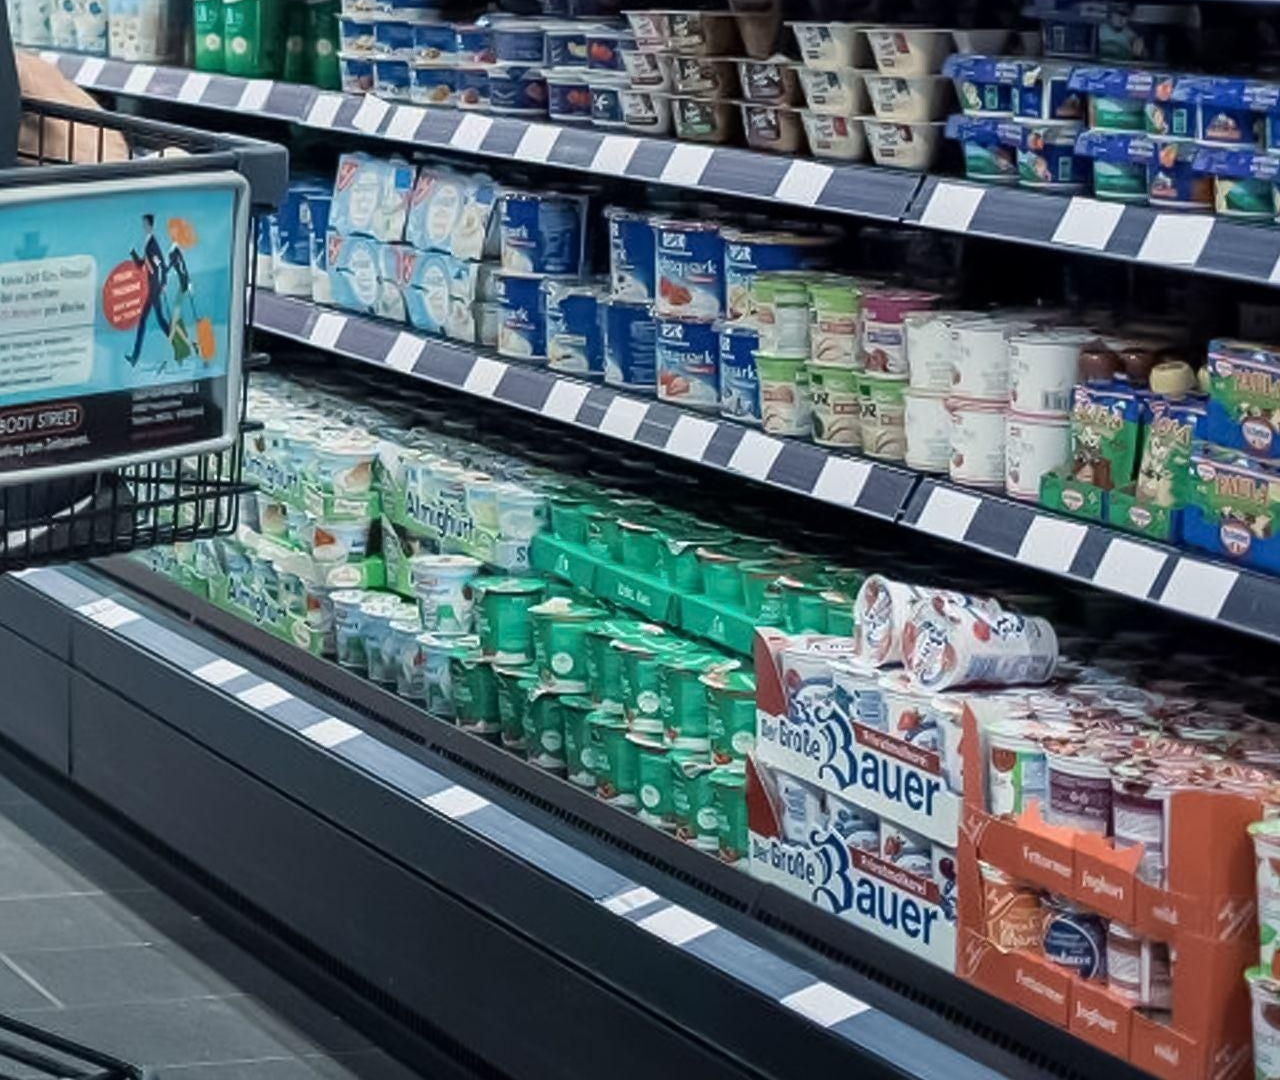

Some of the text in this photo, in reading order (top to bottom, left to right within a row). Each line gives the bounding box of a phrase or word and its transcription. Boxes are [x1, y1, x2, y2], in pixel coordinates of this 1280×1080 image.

[37, 408, 78, 428] STREET
[407, 490, 474, 539] Almighurt
[814, 701, 941, 816] Bauer
[809, 828, 939, 945] Bauer
